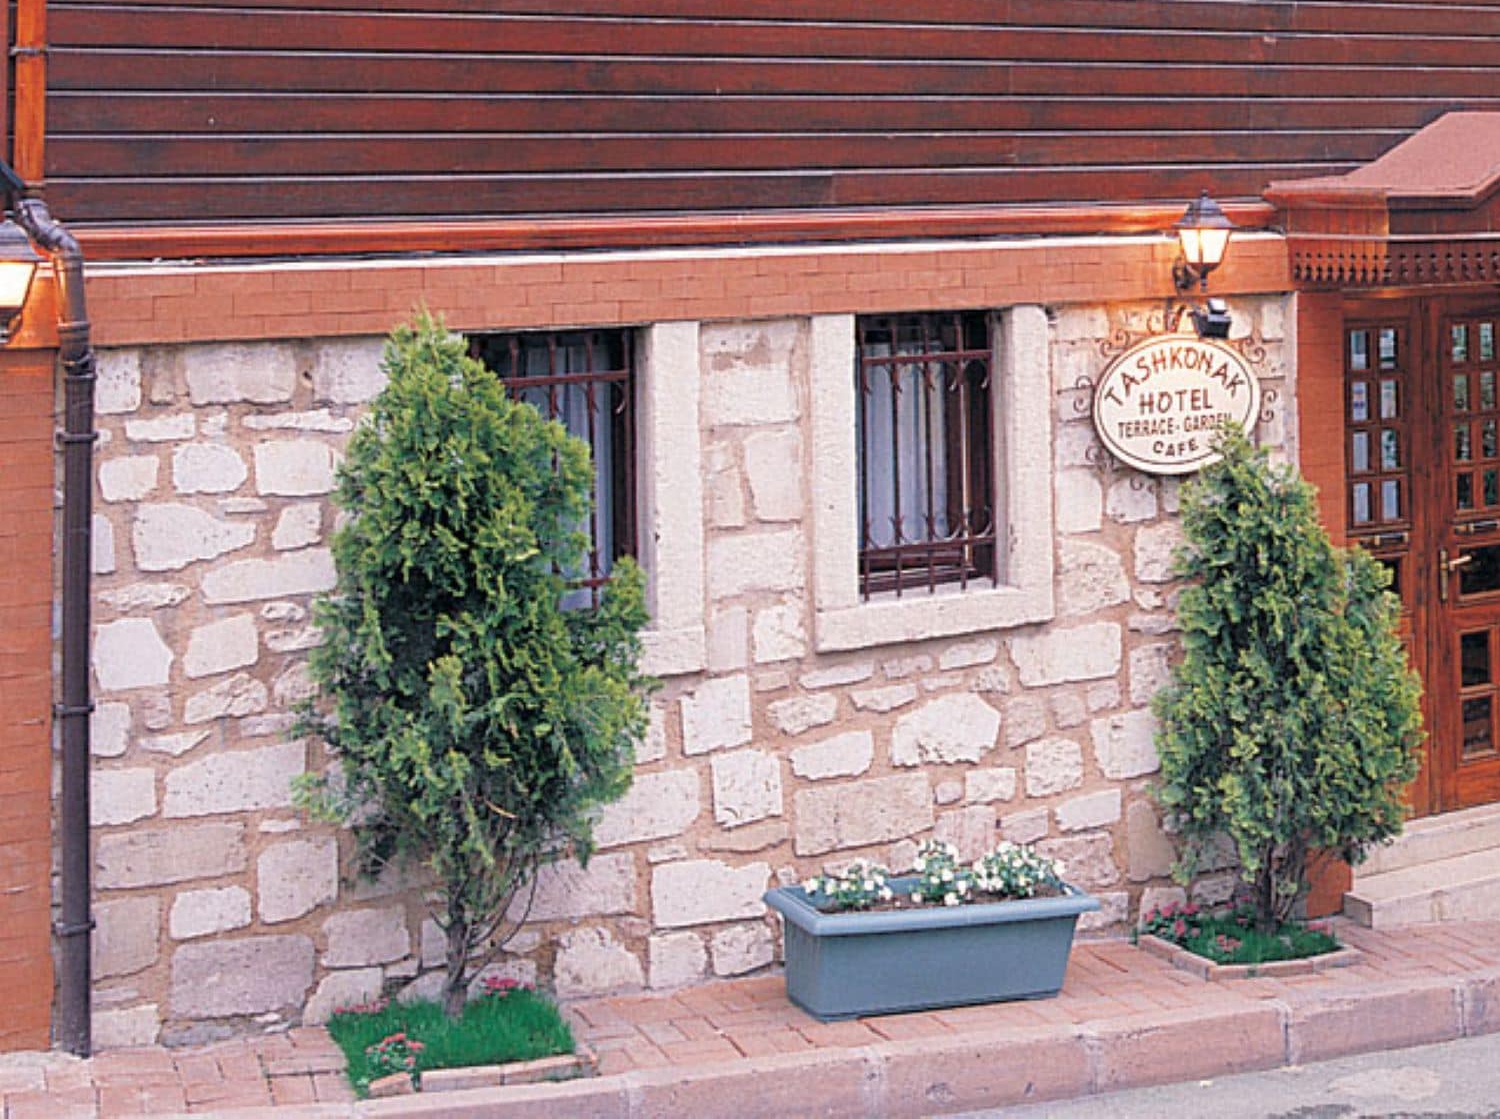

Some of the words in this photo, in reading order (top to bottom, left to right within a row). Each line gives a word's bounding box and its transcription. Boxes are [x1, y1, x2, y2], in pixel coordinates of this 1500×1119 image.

[1104, 346, 1245, 407] TASHKONAK
[1139, 388, 1213, 415] HOTEL
[1153, 438, 1199, 457] CAFE
